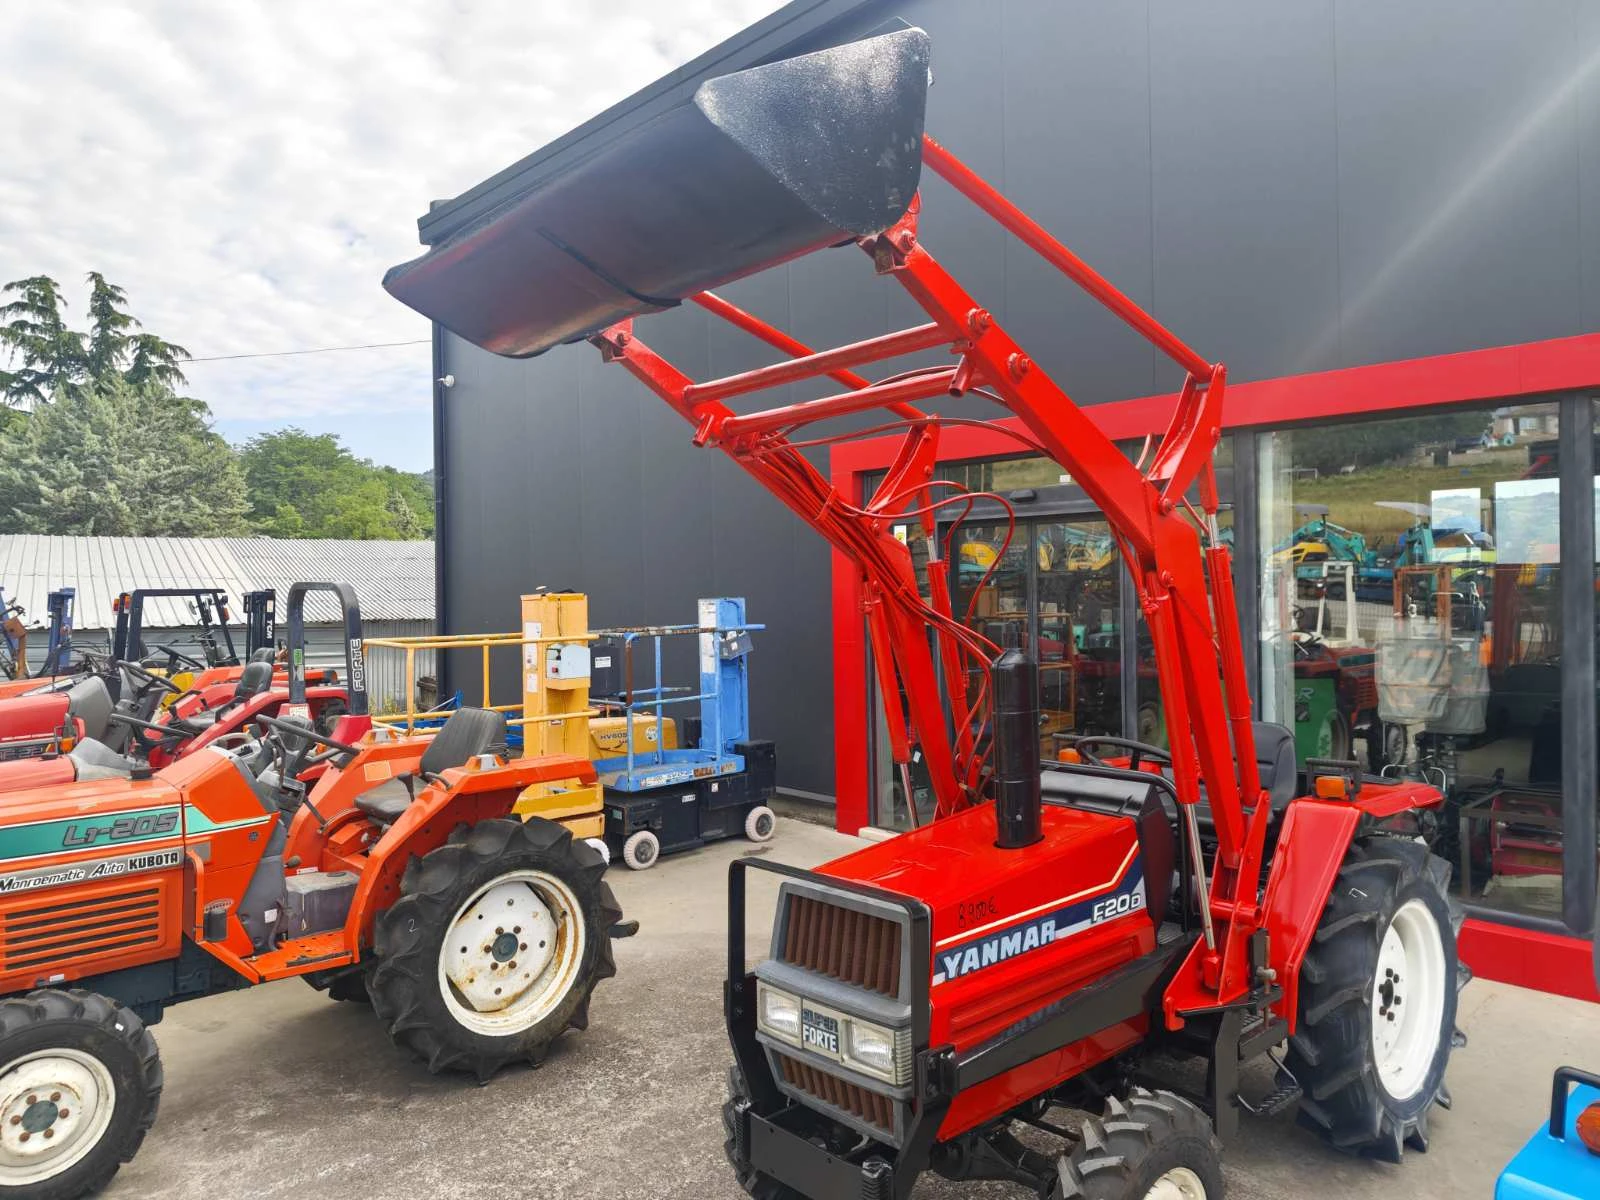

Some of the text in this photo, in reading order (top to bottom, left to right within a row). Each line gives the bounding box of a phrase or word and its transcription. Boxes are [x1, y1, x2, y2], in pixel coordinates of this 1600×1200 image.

[350, 638, 365, 691] FORTE
[0, 853, 178, 891] Monroematic Auto KUBOTA
[1092, 893, 1141, 922] F20D
[943, 919, 1056, 980] YANMAR
[802, 1024, 838, 1053] FORTE
